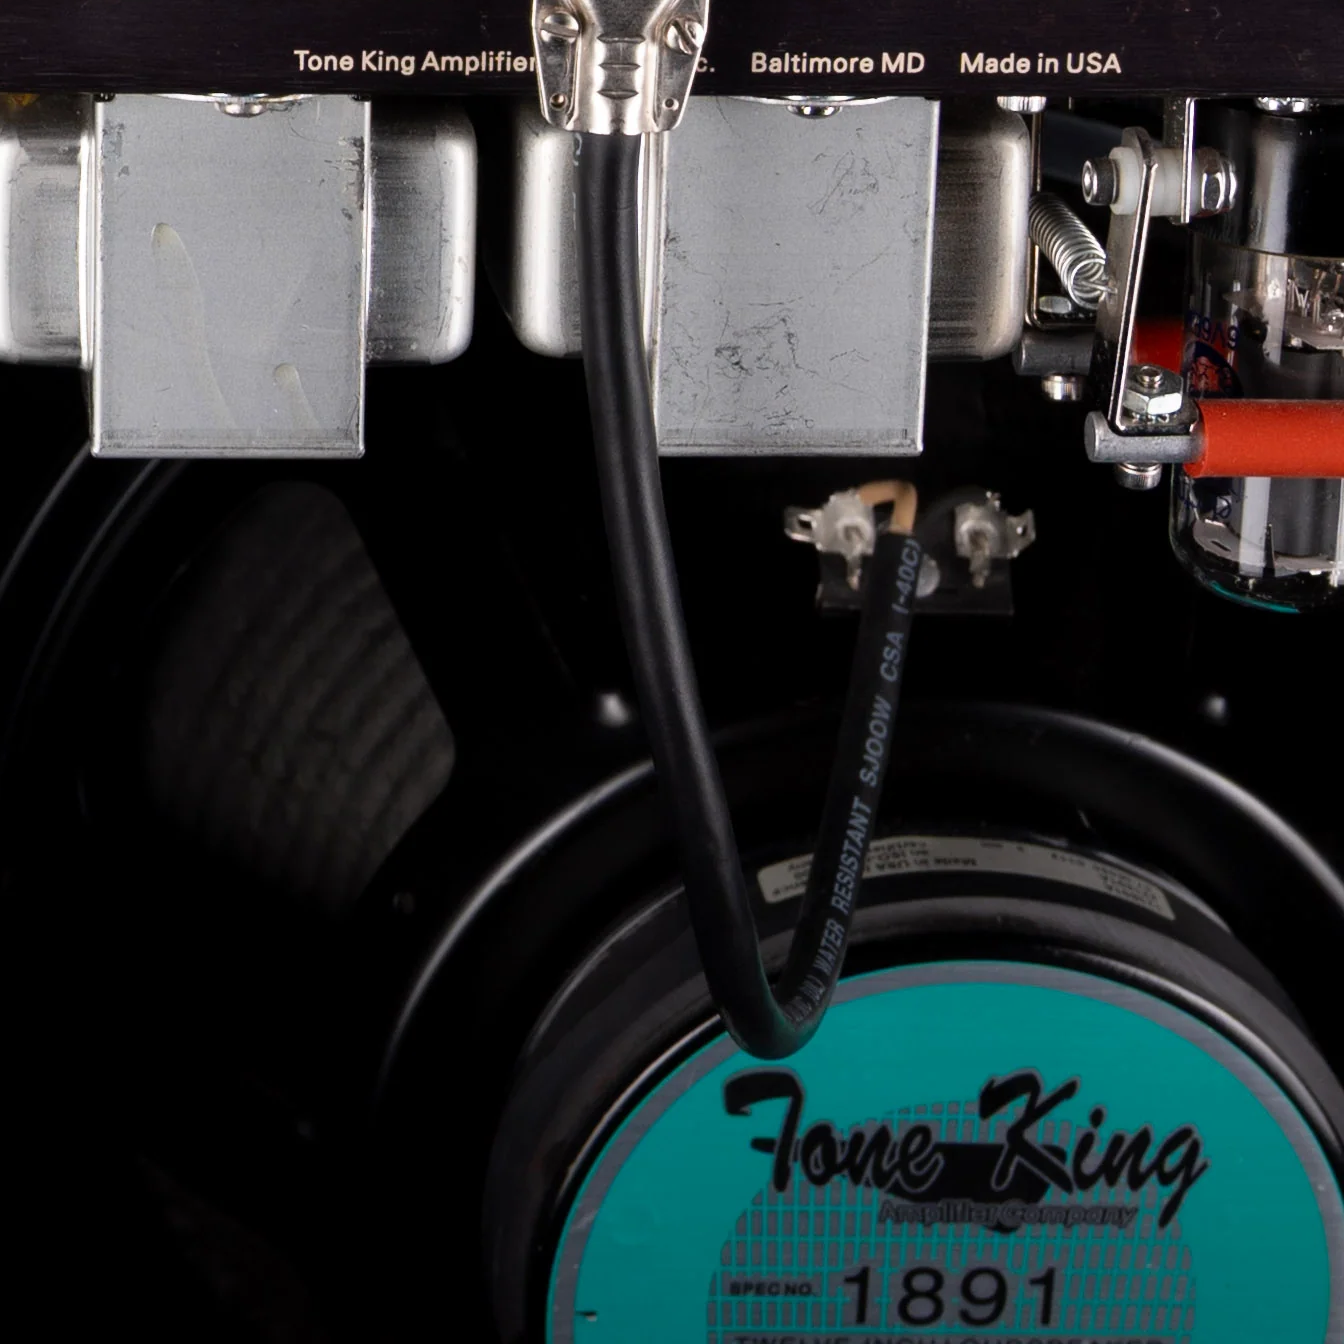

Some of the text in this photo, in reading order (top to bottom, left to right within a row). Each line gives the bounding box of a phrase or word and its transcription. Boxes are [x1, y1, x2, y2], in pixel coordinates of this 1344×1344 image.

[293, 49, 354, 71] Tone
[361, 50, 416, 76] King
[751, 51, 925, 74] Baltimore MD
[960, 51, 1122, 74] Made in USA
[816, 918, 846, 976] WATER
[831, 795, 874, 918] RESISTANT
[859, 695, 893, 788] SJOOW
[879, 630, 906, 683] CSA
[723, 1066, 1211, 1228] Tone King
[997, 1197, 1138, 1228] Company
[729, 1282, 782, 1297] SPEC
[844, 1266, 1055, 1326] 1891
